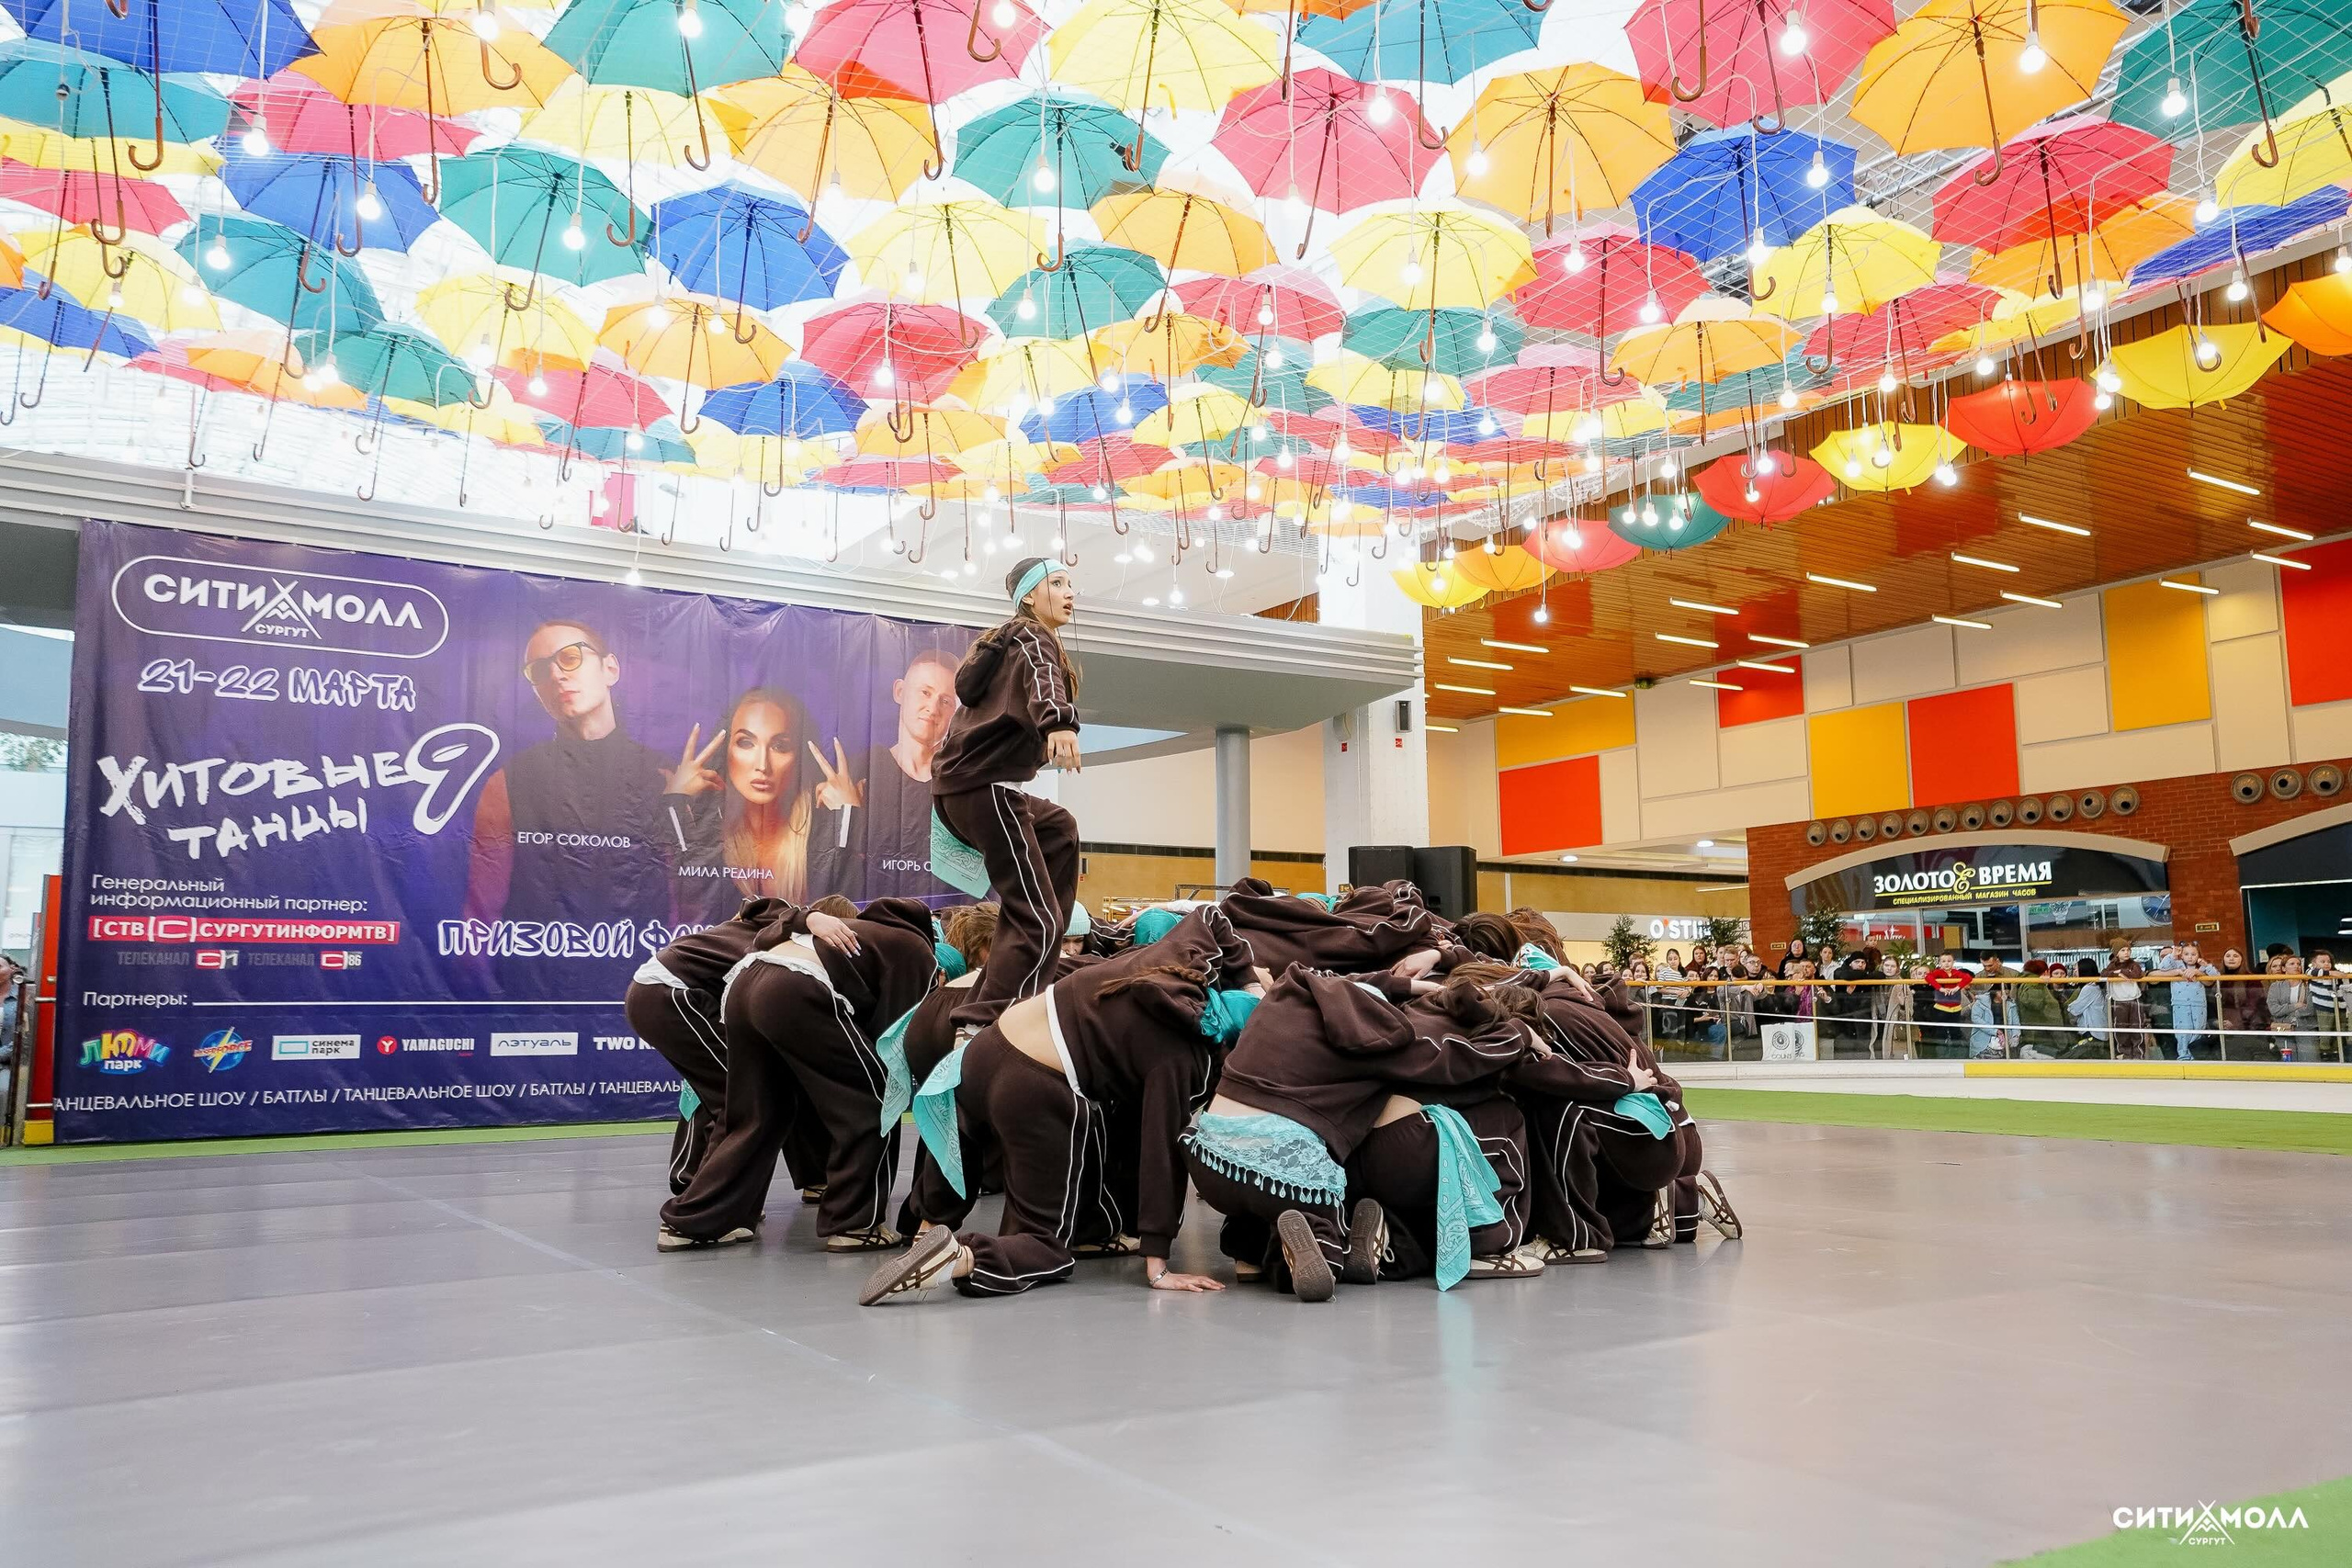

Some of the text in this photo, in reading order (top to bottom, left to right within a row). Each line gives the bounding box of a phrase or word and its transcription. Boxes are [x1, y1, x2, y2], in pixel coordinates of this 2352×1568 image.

[143, 573, 423, 629] СИТИ МОЛЛ
[254, 623, 310, 638] СУРГУТ
[138, 658, 417, 712] 21-22 МАРТА
[97, 751, 411, 825] ХИТОВЫЕ
[168, 796, 368, 859] ТАНЦЫ
[517, 831, 631, 848] ЕГОР СОКОЛОВ
[678, 865, 775, 880] МИЛА РЕДИНА
[883, 860, 921, 872] ИГОРЬ
[92, 874, 225, 892] Генеральный
[1873, 871, 1956, 894] ЗОЛОТО
[1978, 862, 2052, 886] ВРЕМЯ
[91, 891, 368, 913] информационный партнер:
[1893, 887, 2037, 906] СПЕЦИАЛИЗИРОВАННЫЙ МАГАЗИН ЧАСОВ
[437, 919, 635, 958] ПРИЗОВОЙ
[118, 952, 189, 965] ТЕЛЕКАНАЛ
[248, 953, 314, 966] ТЕЛЕКАНАЛ
[83, 991, 187, 1009] Партнеры:
[401, 1038, 474, 1052] YAMAGUCHI
[593, 1037, 635, 1050] TWO
[104, 1059, 142, 1072] парк
[199, 1091, 246, 1107] ШОУ
[264, 1089, 327, 1105] БАТТЛЫ
[344, 1085, 471, 1103] ТАНЦЕВАЛЬНОЕ
[476, 1084, 515, 1099] ШОУ
[530, 1082, 585, 1097] БАТТЛЫ
